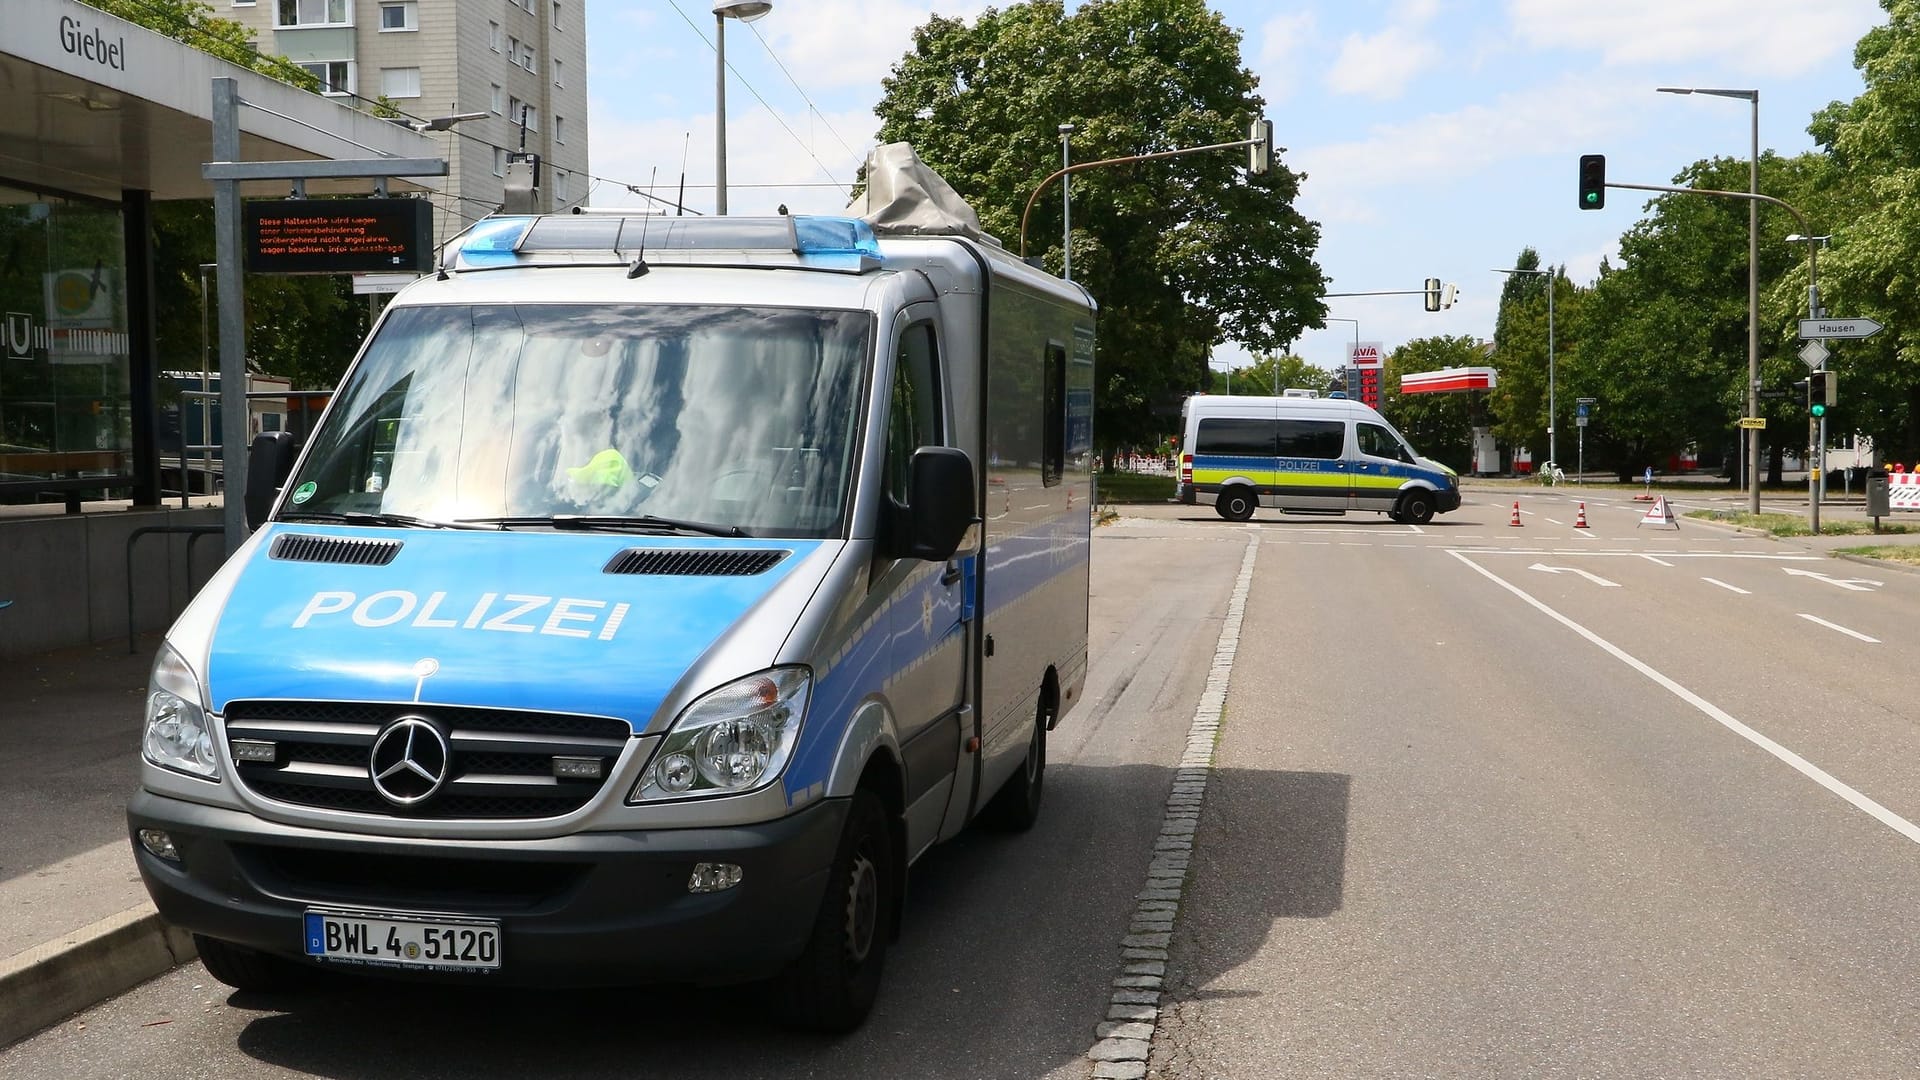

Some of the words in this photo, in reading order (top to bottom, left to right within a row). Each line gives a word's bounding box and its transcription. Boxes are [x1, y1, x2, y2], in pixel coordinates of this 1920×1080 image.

[60, 15, 125, 72] Giebel
[259, 217, 281, 226] Diese
[284, 216, 328, 225] Haltestelle
[320, 235, 342, 243] nicht
[1818, 324, 1855, 333] Hausen
[9, 316, 30, 355] U
[1353, 346, 1377, 356] AVIA
[1278, 460, 1320, 471] POLIZEI
[291, 589, 632, 642] POLIZEI
[312, 938, 320, 948] D
[325, 921, 378, 955] BWL
[386, 926, 402, 957] 4
[424, 928, 496, 962] 5120
